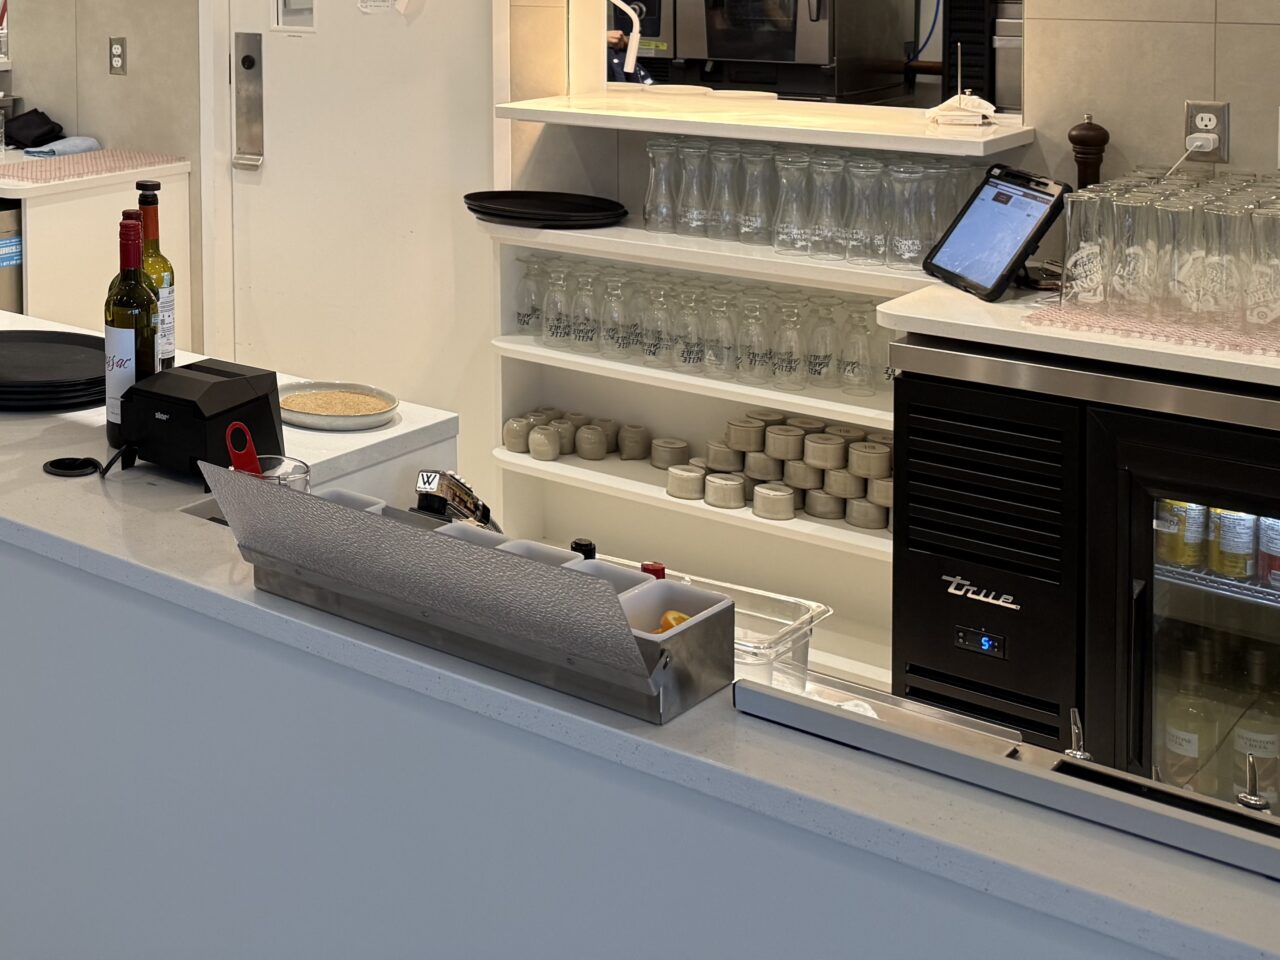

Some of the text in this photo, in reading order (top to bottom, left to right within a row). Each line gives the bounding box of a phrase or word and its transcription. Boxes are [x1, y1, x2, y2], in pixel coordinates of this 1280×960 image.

[421, 473, 438, 486] W
[941, 575, 1021, 610] true
[981, 636, 990, 650] 5
